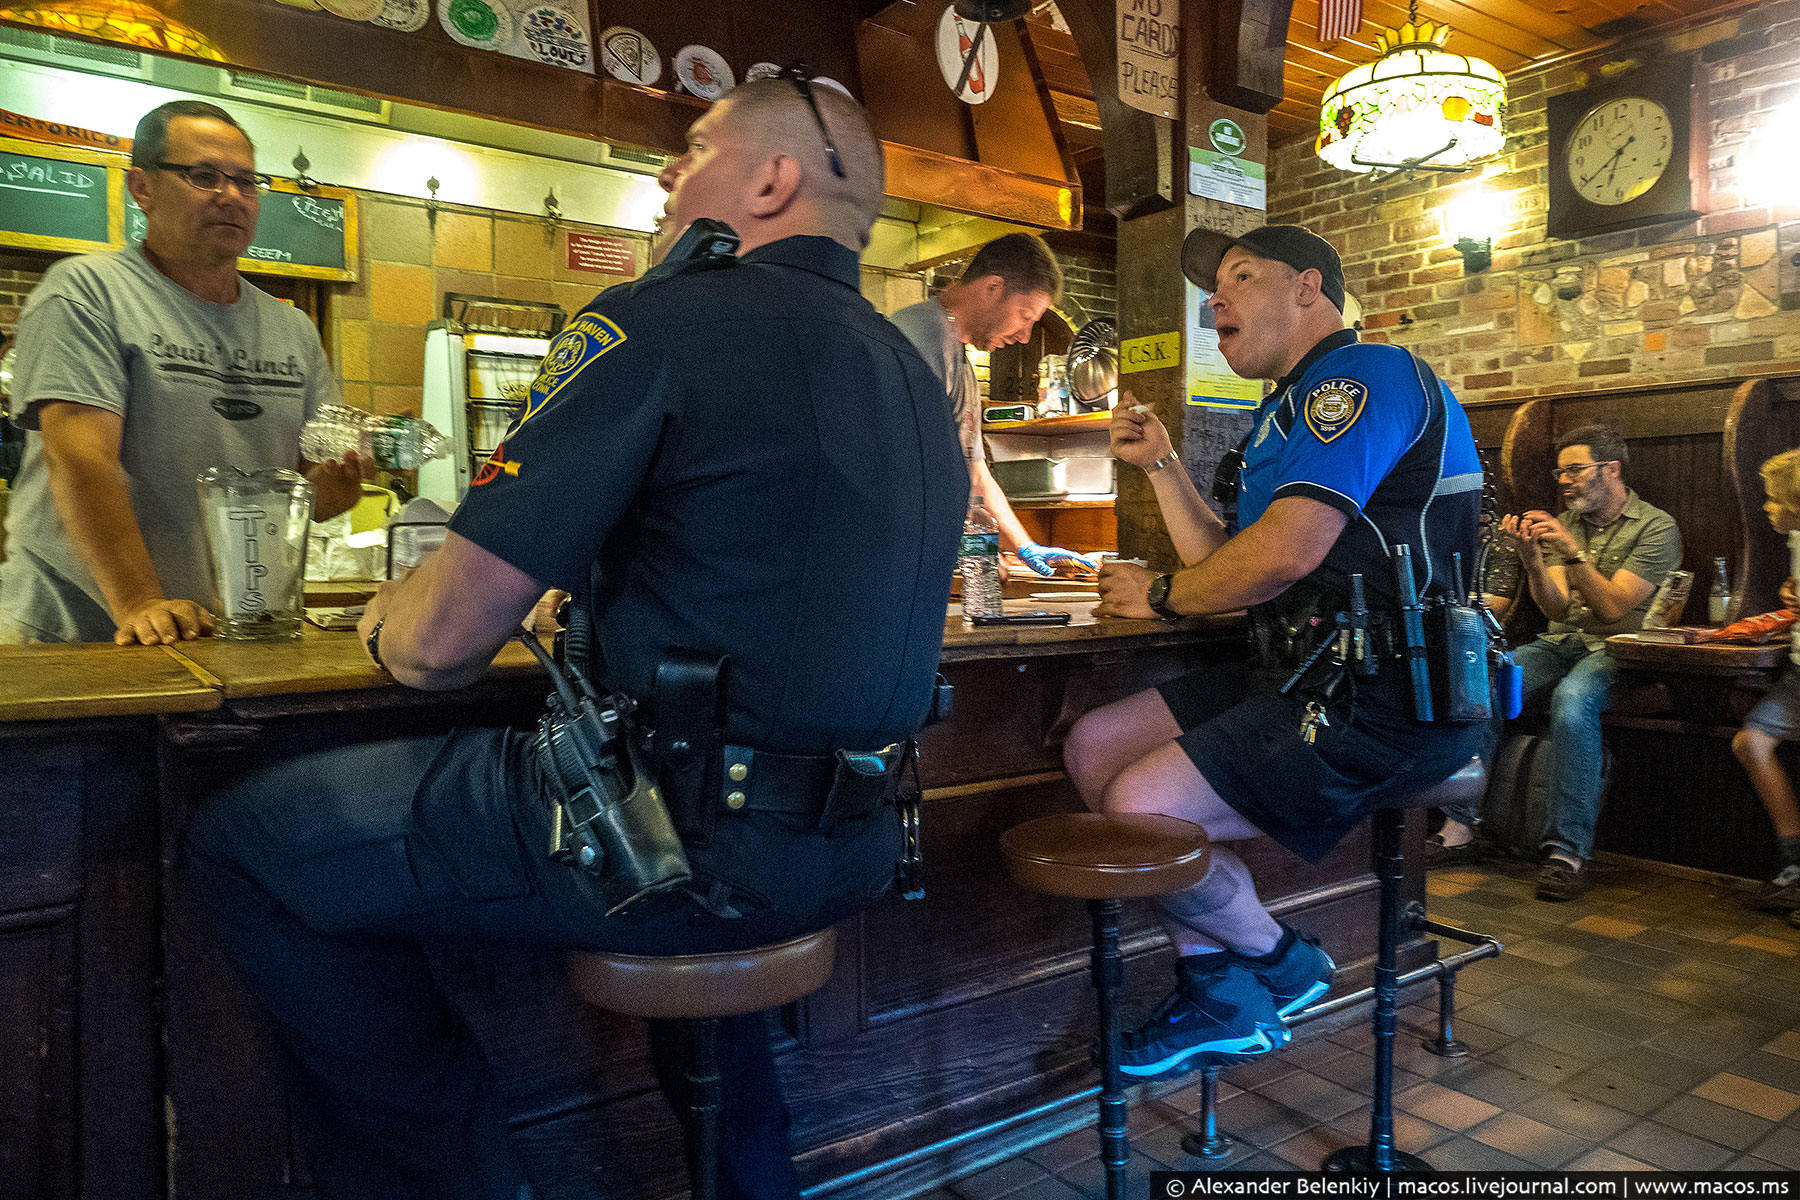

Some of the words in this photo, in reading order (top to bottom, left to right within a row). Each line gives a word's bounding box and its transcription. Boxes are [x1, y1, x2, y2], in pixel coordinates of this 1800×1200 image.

[1121, 13, 1180, 58] CARDS
[1121, 61, 1178, 100] PLEASE
[577, 320, 614, 347] HAVEN
[1128, 341, 1171, 364] C.S.K.
[1311, 381, 1361, 398] POLICE
[227, 509, 268, 614] TIPS
